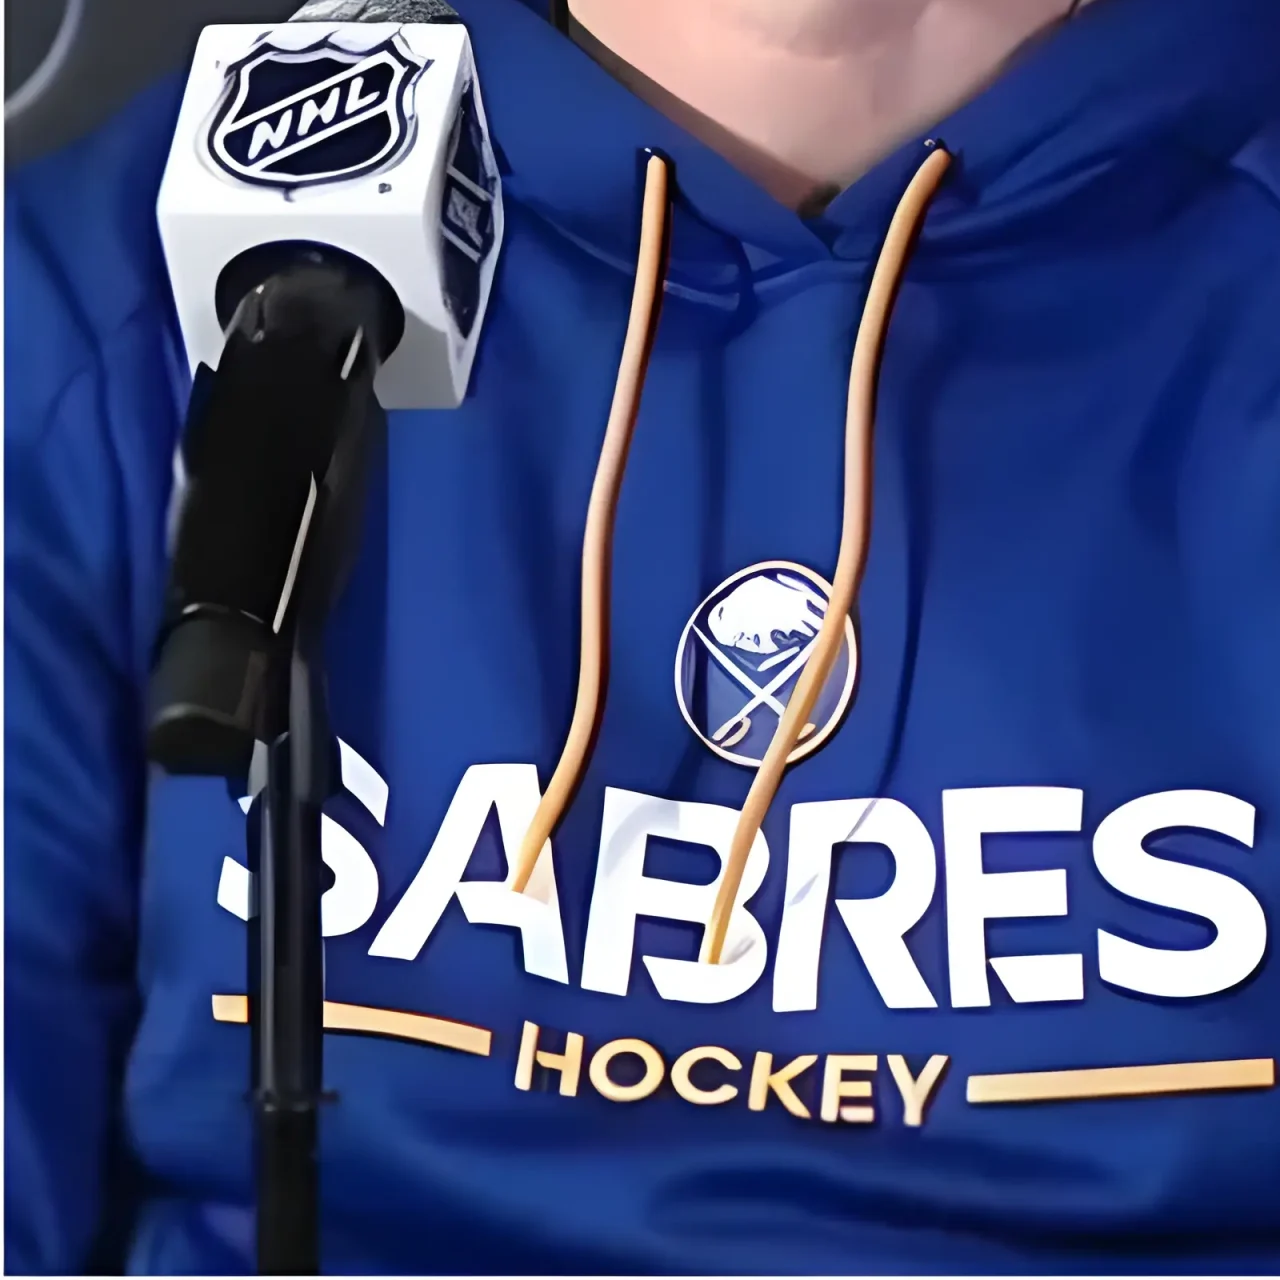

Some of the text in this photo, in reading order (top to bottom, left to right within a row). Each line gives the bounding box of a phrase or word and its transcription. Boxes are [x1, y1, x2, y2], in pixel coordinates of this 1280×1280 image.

[247, 76, 381, 160] NHL
[217, 734, 1268, 1013] SABRES
[513, 1020, 950, 1128] HOCKEY
